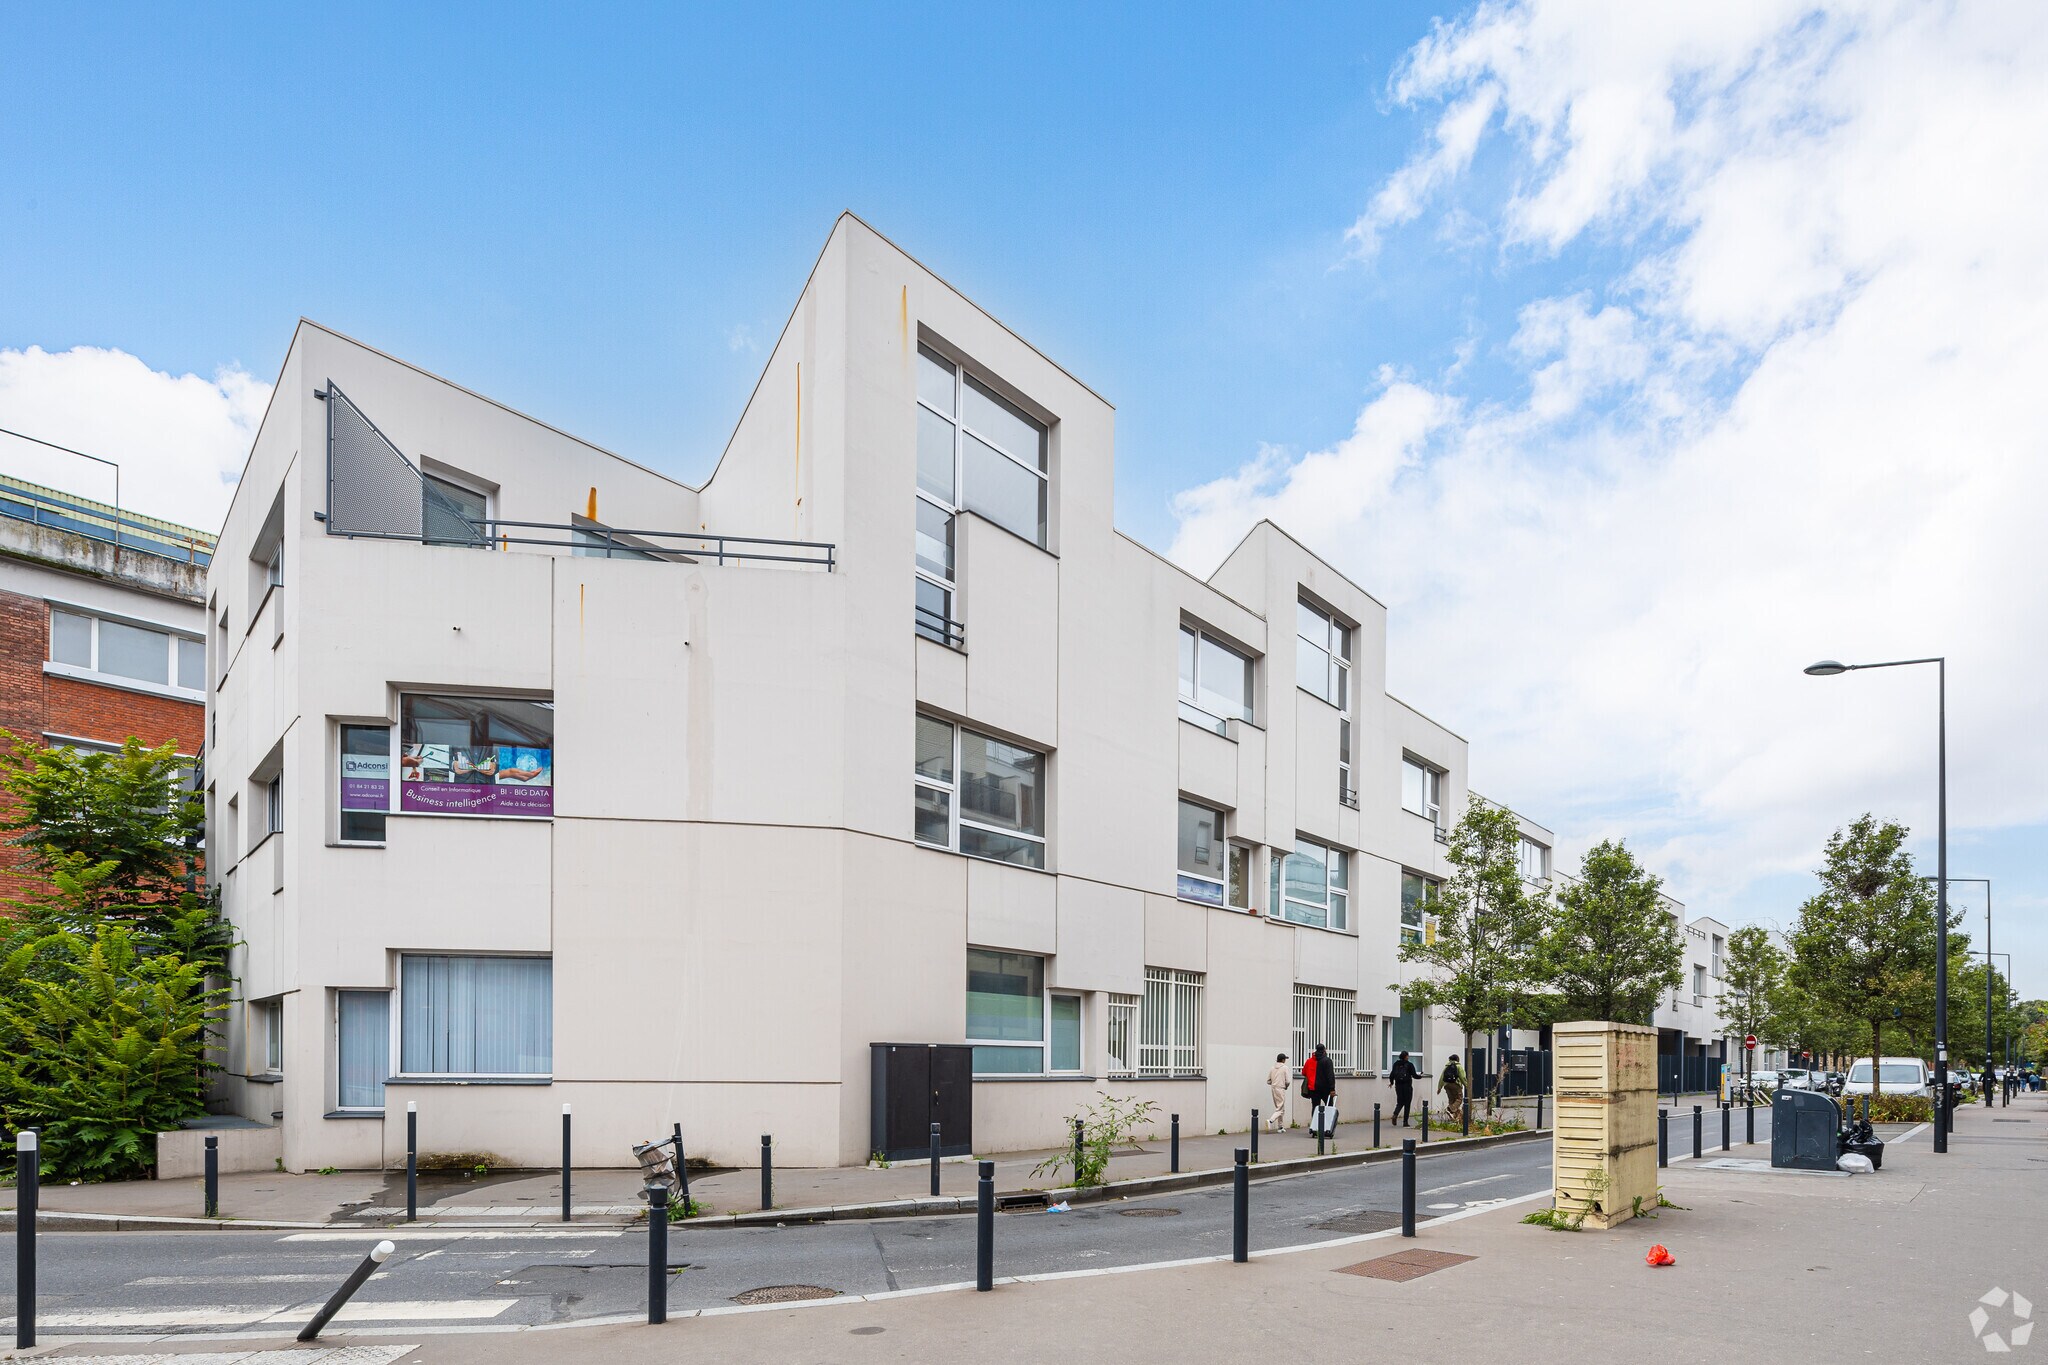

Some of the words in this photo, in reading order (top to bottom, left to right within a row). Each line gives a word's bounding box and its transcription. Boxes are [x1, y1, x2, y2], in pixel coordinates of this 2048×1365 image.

[357, 762, 388, 770] Adconsi
[406, 788, 443, 807] Business
[446, 793, 497, 808] intelligence
